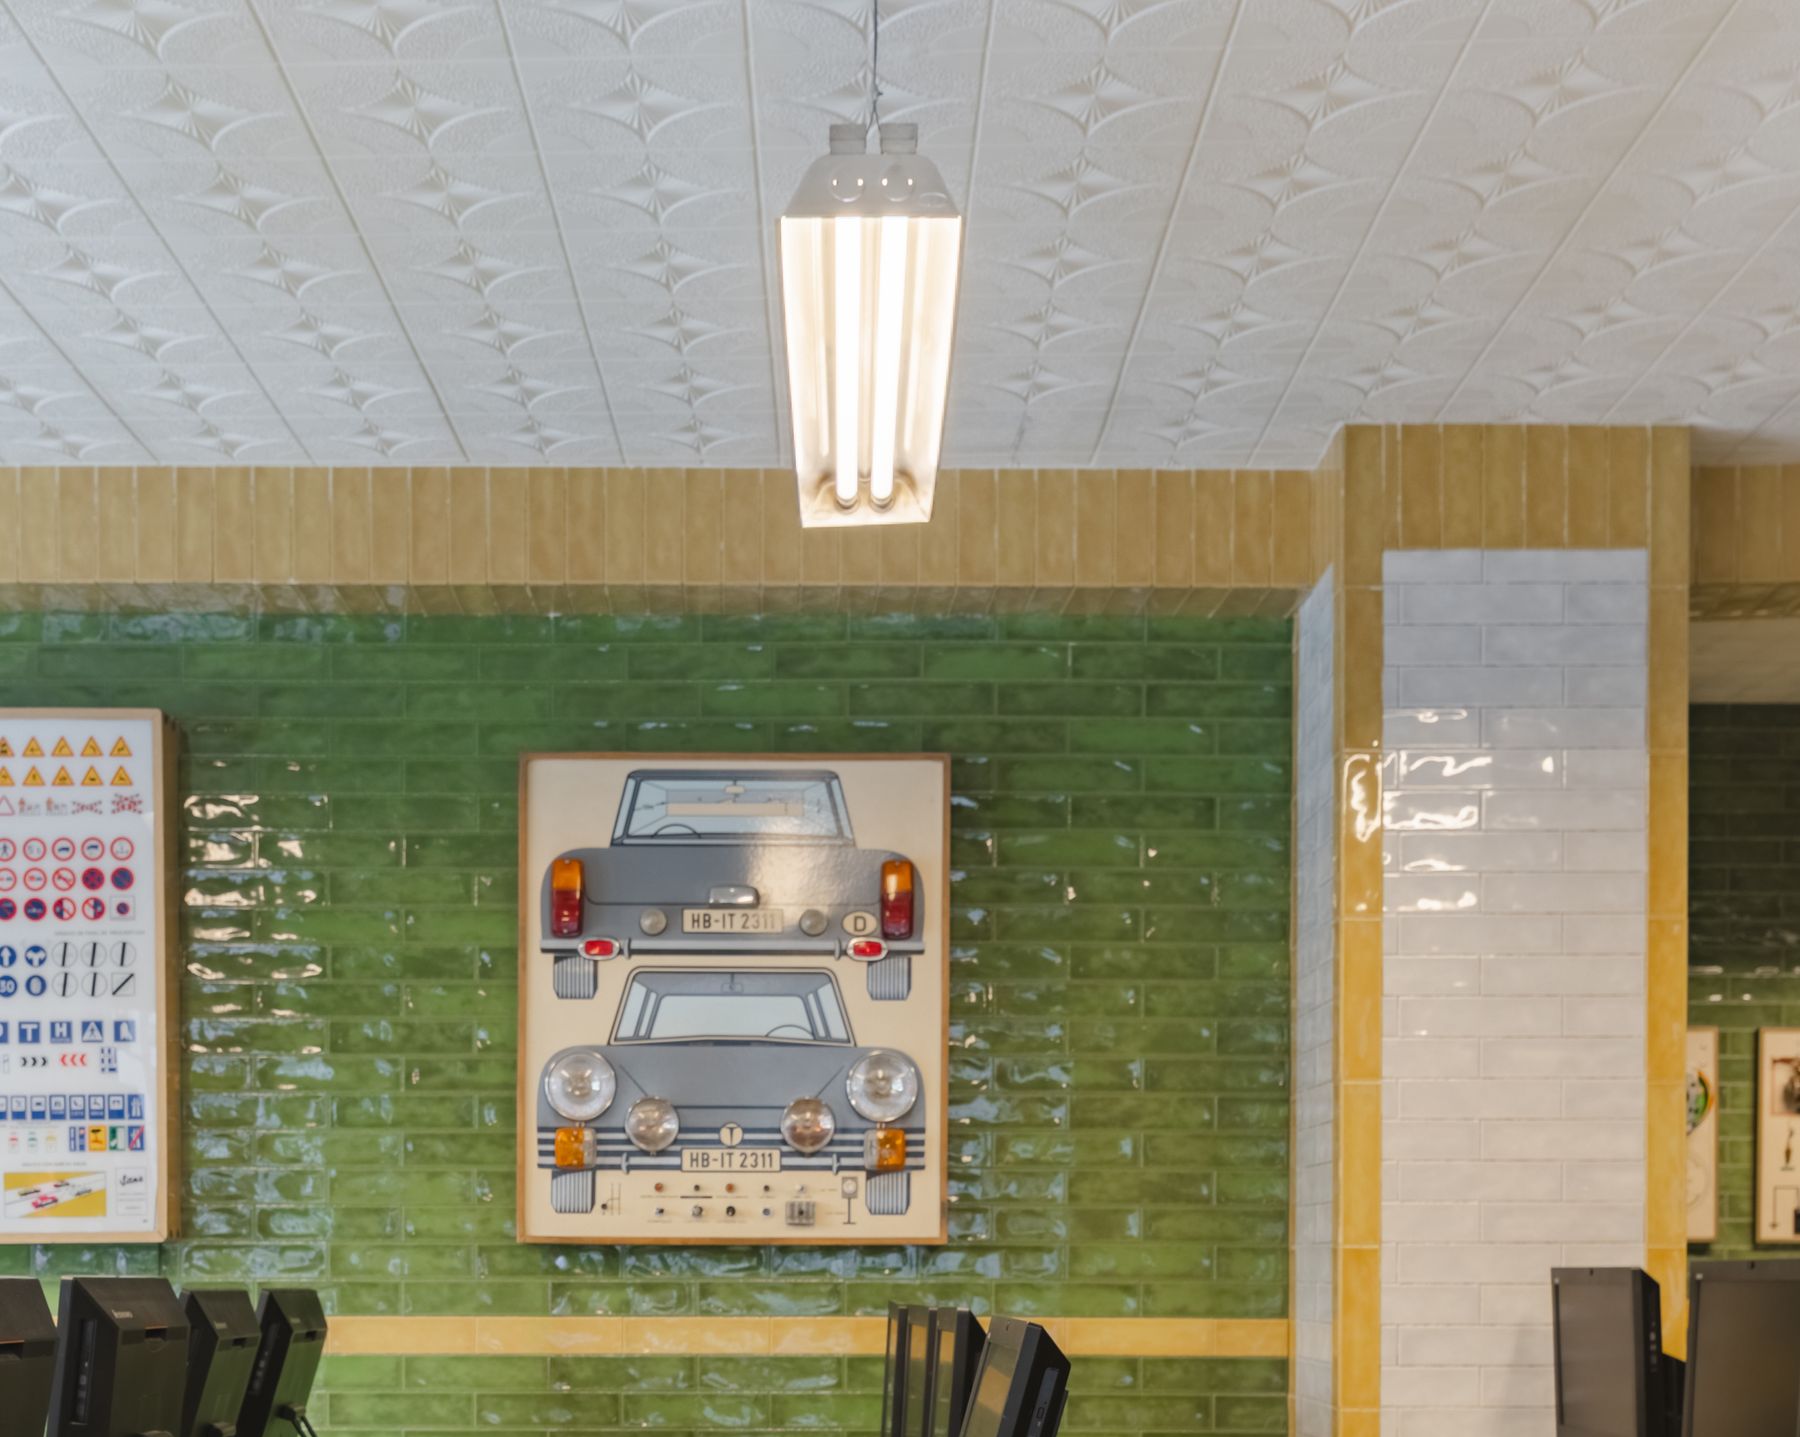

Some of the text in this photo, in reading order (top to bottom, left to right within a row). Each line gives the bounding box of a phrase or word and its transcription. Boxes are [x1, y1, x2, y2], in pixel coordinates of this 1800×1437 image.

[690, 913, 776, 930] HB-IT 2311
[854, 916, 866, 932] D
[54, 1023, 67, 1038] H
[689, 1152, 773, 1168] HB-IT 2311
